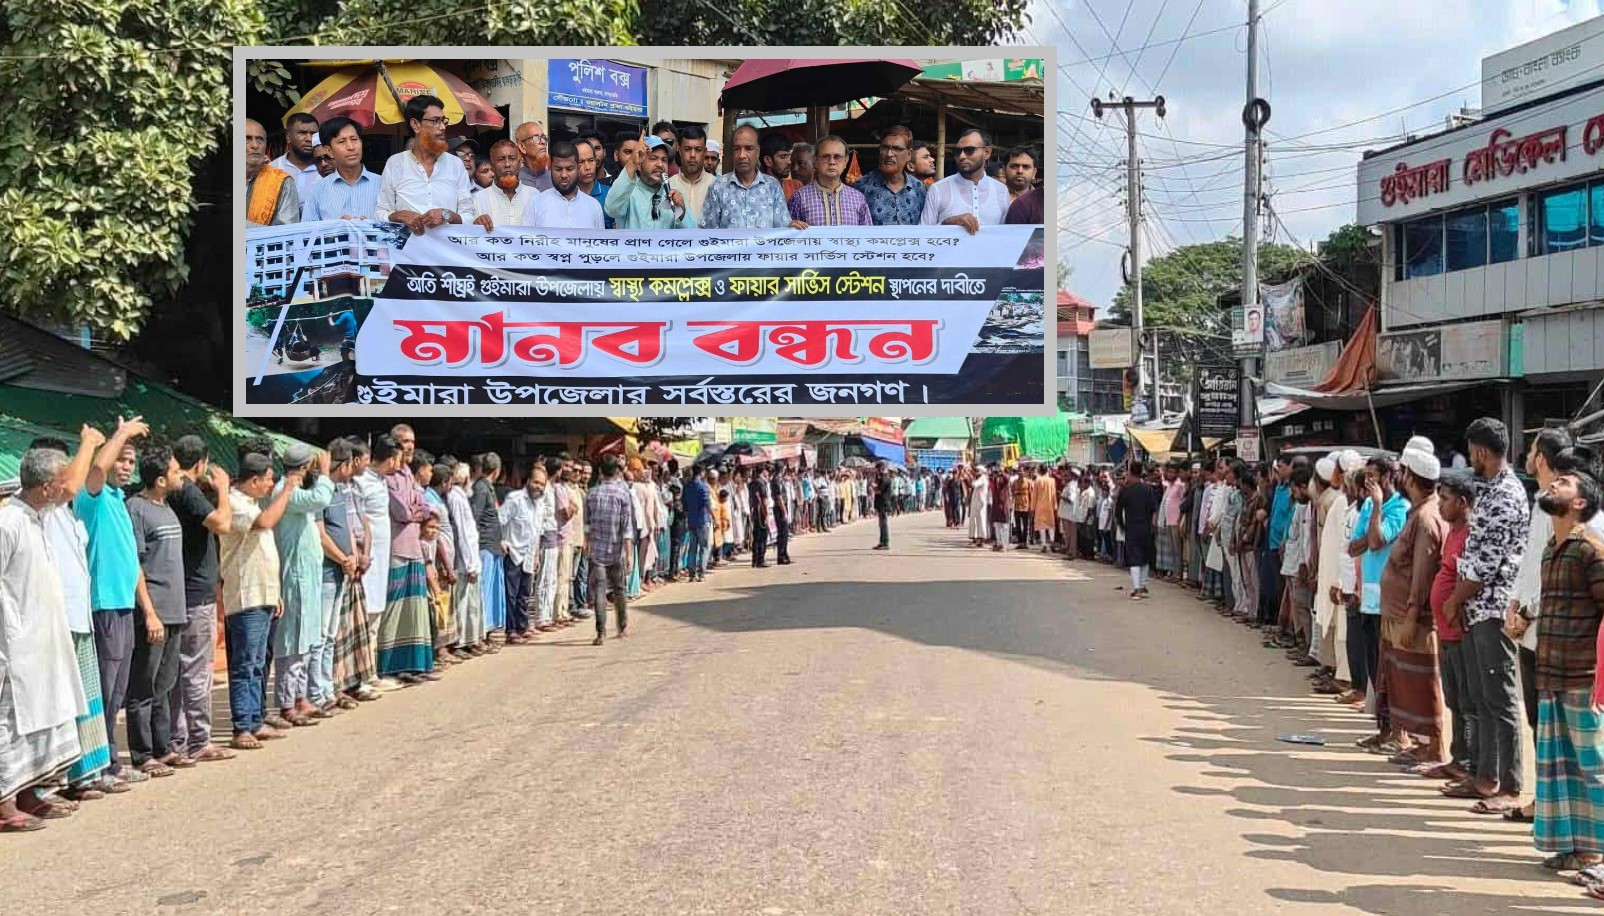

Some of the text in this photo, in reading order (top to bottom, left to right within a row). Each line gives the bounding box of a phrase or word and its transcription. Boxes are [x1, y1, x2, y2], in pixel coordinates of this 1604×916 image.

[568, 59, 631, 90] পুলিশ বক্স
[1380, 159, 1452, 207] গুইমারা
[1464, 128, 1568, 186] মেডিকেল
[447, 234, 960, 249] আর কত নিরীহ মানুষের প্রাণ গেলে গুইমারা উপজেলায় স্বাস্থ্য কমপ্লেক্স হবে?
[476, 250, 936, 265] আর কত স্বপ্ন পুড়লে গুইমারা উপজেলায় ফায়ার সার্ভিস স্টেশন হবে?
[407, 272, 436, 295] অতি
[480, 275, 531, 297] গুইমারা
[536, 276, 606, 298] উপজেলায়
[609, 276, 645, 302] স্বাস্থ্য
[648, 276, 711, 302] কমপ্লেক্স
[714, 281, 725, 294] ও
[729, 275, 780, 296] ফায়ার
[784, 269, 831, 296] সার্ভিস
[835, 270, 885, 295] স্টেশন
[889, 277, 937, 299] স্থাপনের
[941, 272, 986, 296] দাবীতে
[393, 310, 941, 367] মানব বন্ধন
[357, 378, 474, 404] গুইমারা
[482, 377, 652, 404] উপজেলার
[658, 376, 797, 404] সর্বস্তরের
[804, 380, 911, 404] জনগণ
